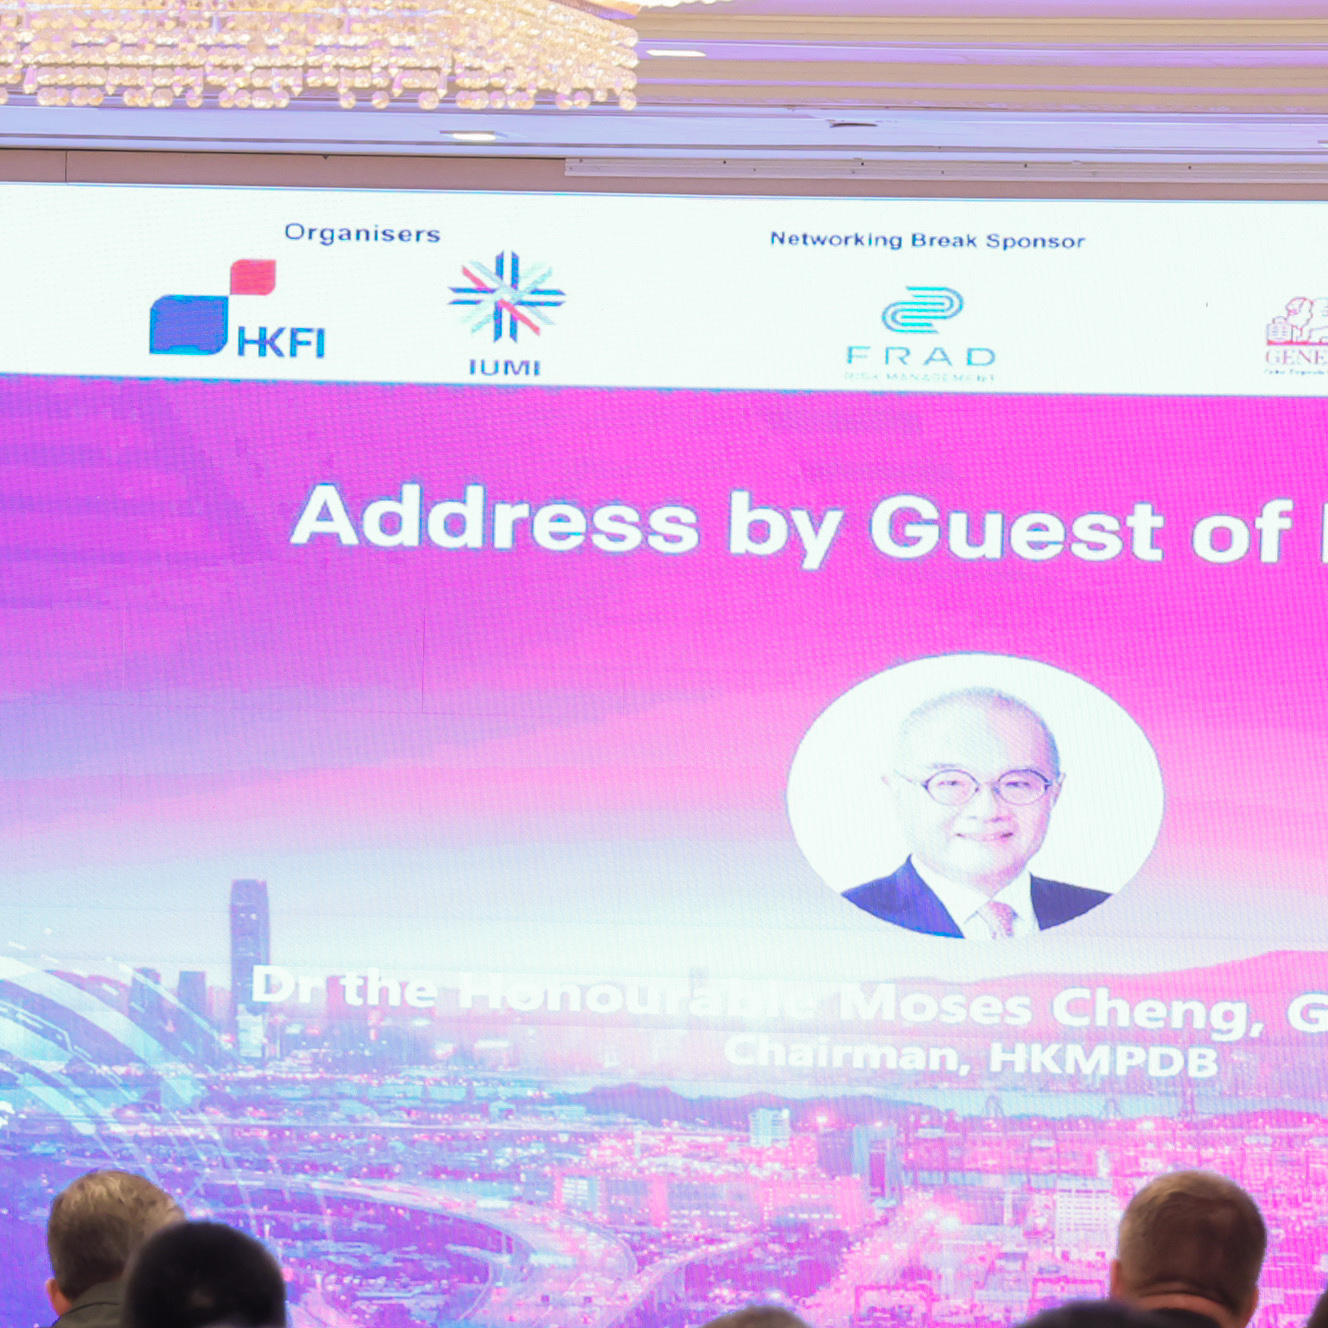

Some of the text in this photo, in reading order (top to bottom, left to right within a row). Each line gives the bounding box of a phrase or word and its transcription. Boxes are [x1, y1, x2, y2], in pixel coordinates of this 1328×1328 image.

[284, 222, 441, 246] Organisers
[770, 231, 1087, 251] Networking Break Sponsor
[237, 326, 325, 359] HKFI
[846, 345, 996, 367] FRAD
[469, 358, 540, 377] IUMI
[289, 481, 700, 554] Address
[729, 489, 845, 571] by
[870, 493, 1165, 562] Guest
[1191, 498, 1294, 564] of
[251, 964, 325, 1003] Dr
[339, 967, 439, 1008] the
[458, 973, 816, 1020] Honourable
[838, 981, 1033, 1026] Moses
[1052, 986, 1265, 1044] Cheng,
[723, 1032, 1219, 1079] Chairman, HKMPDB
